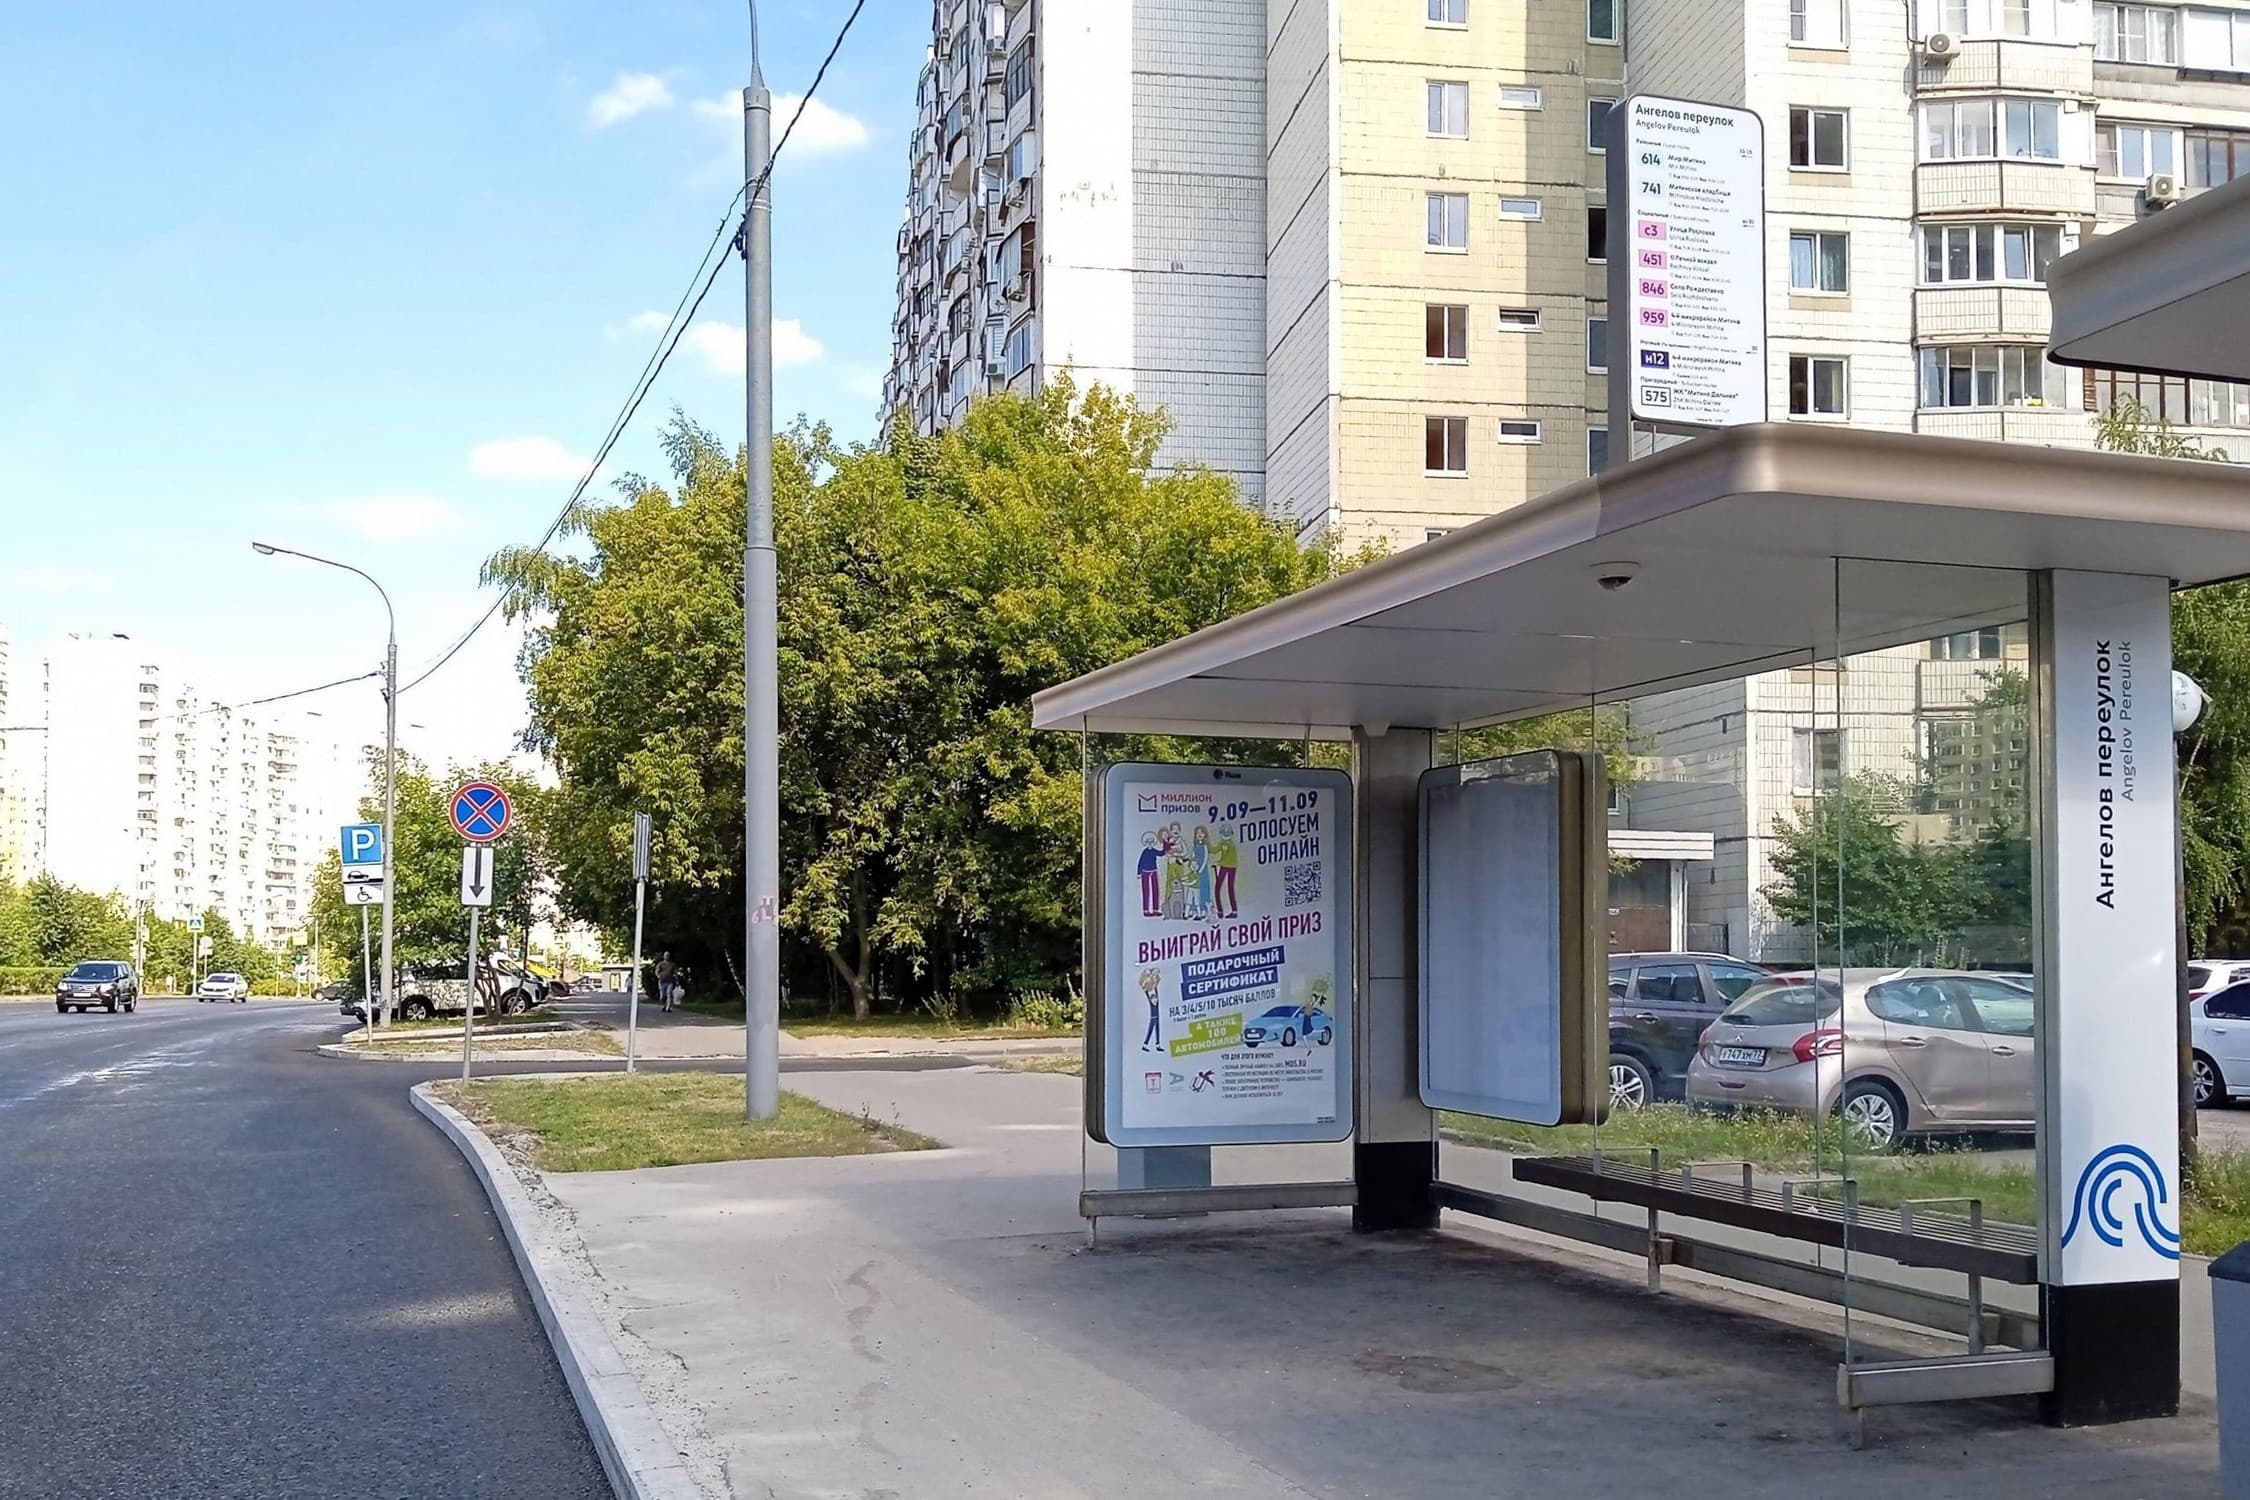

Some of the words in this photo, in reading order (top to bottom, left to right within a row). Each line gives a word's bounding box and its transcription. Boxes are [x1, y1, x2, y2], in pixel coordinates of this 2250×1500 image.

[1635, 103, 1681, 120] Ангелов
[1683, 111, 1735, 127] переулок
[1635, 119, 1666, 130] Angelov
[1667, 123, 1700, 134] Pereulok
[1641, 152, 1661, 166] 614
[1641, 181, 1661, 195] 741
[1644, 224, 1658, 237] с3
[1643, 252, 1662, 266] 451
[1642, 281, 1665, 295] 846
[1642, 310, 1665, 324] 959
[1645, 352, 1665, 365] н12
[1645, 390, 1667, 403] 575
[2117, 639, 2133, 721] Pereulok
[2096, 639, 2116, 778] переулок
[2119, 728, 2136, 802] Angelov
[1160, 803, 1201, 815] призов
[1239, 812, 1319, 843] ГОЛОСУЕМ
[351, 829, 375, 860] P
[1257, 834, 1320, 865] ОНЛАЙН
[2095, 786, 2115, 910] Ангелов
[1138, 924, 1221, 964] ВЫИГРАЙ
[1228, 915, 1272, 948] СВОЙ
[1278, 911, 1322, 940] ПРИЗ
[1187, 948, 1281, 977] ПОДАРОЧНЫЙ
[1188, 969, 1275, 995] СЕРТИФИКАТ
[1169, 1006, 1181, 1017] НА
[1182, 1000, 1216, 1016] 3/4/5/10
[1218, 994, 1244, 1009] ТЫСЯЧ
[1245, 988, 1276, 1004] БАЛЛОВ
[1205, 1017, 1237, 1029] ТАКЖЕ
[1208, 1027, 1227, 1038] 100
[1175, 1034, 1241, 1053] АВТОМОБИЛЕЙ
